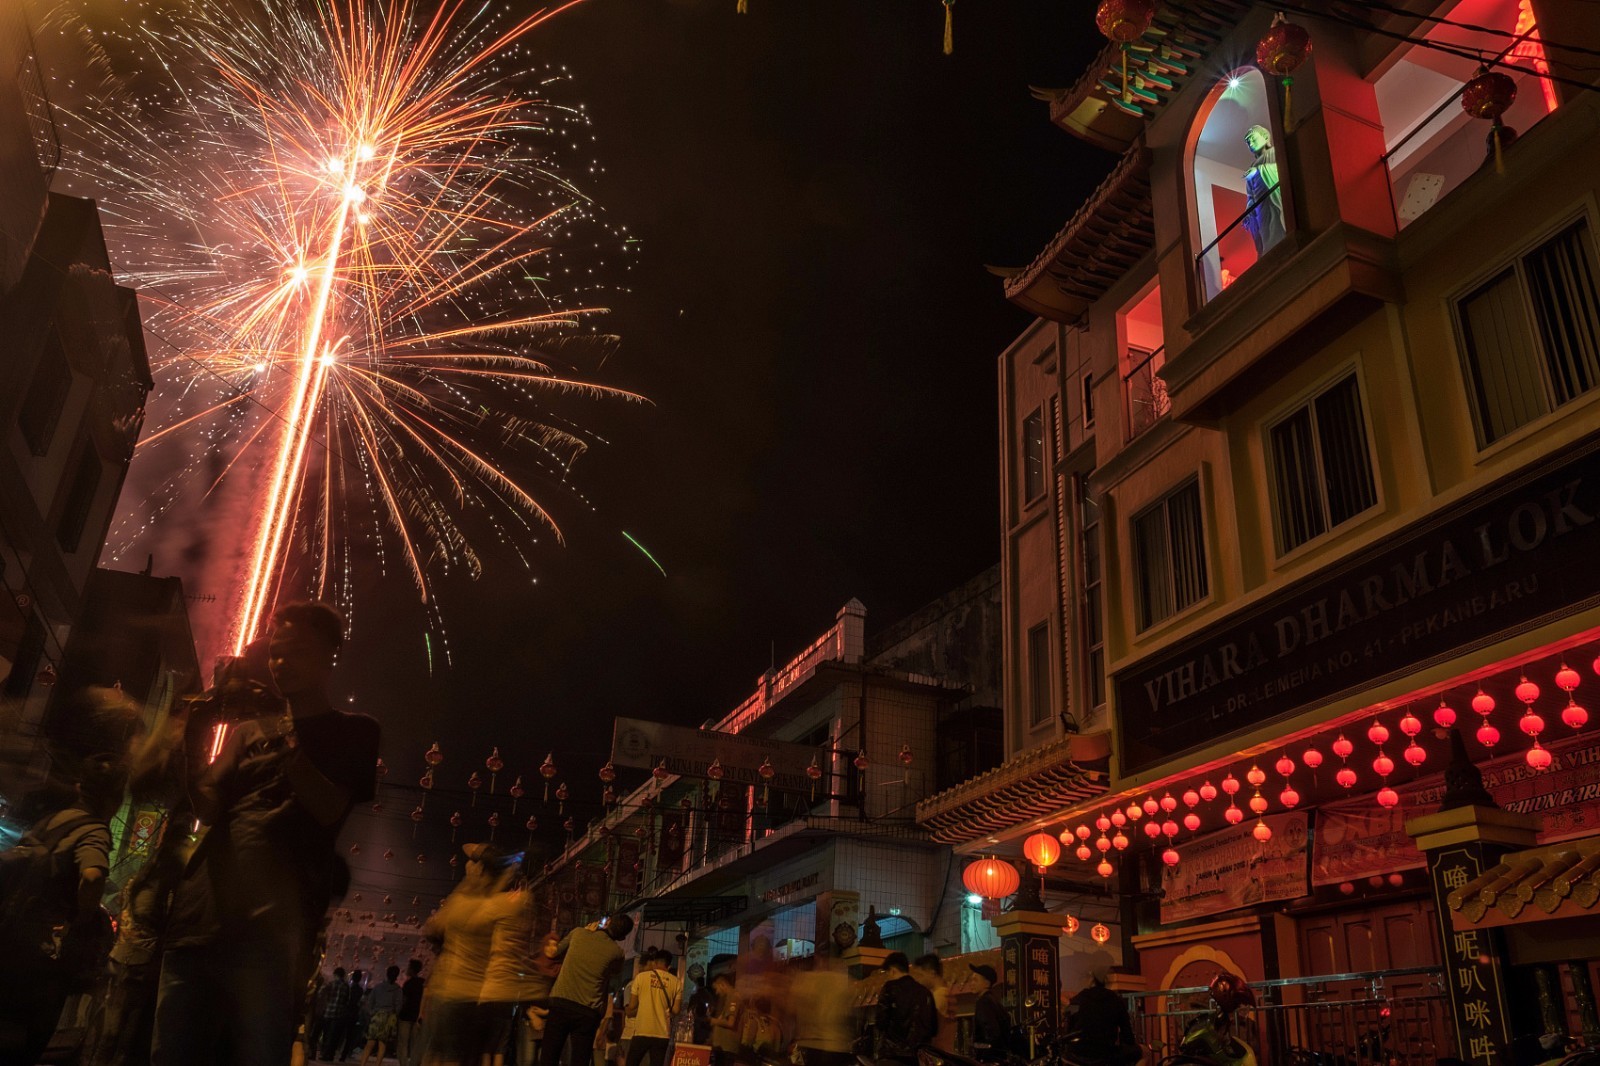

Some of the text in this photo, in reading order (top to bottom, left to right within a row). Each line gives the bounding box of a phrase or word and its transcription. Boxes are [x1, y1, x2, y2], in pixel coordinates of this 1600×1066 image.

[1143, 478, 1600, 713] VIHARA DHARMA LOK
[1226, 692, 1252, 713] DR.
[1326, 649, 1358, 674] NO.
[1363, 639, 1384, 659] 41
[1401, 573, 1539, 648] PEKANBARU
